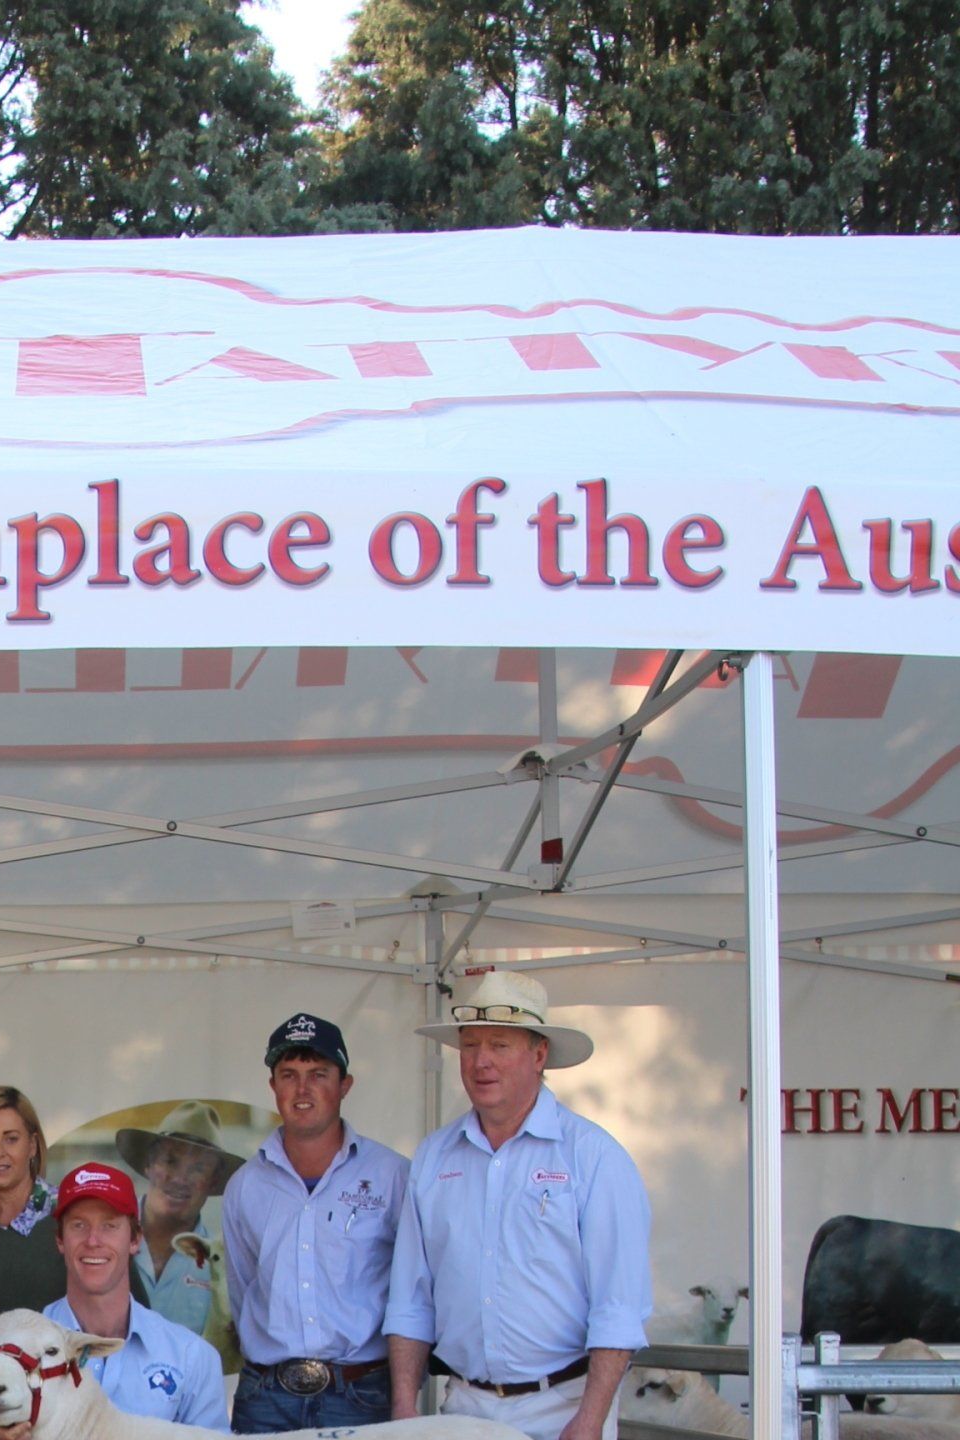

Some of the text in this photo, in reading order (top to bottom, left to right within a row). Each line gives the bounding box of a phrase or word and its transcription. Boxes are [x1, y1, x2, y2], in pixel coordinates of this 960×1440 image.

[368, 477, 507, 586] of
[528, 478, 725, 588] the
[739, 1087, 865, 1134] HE
